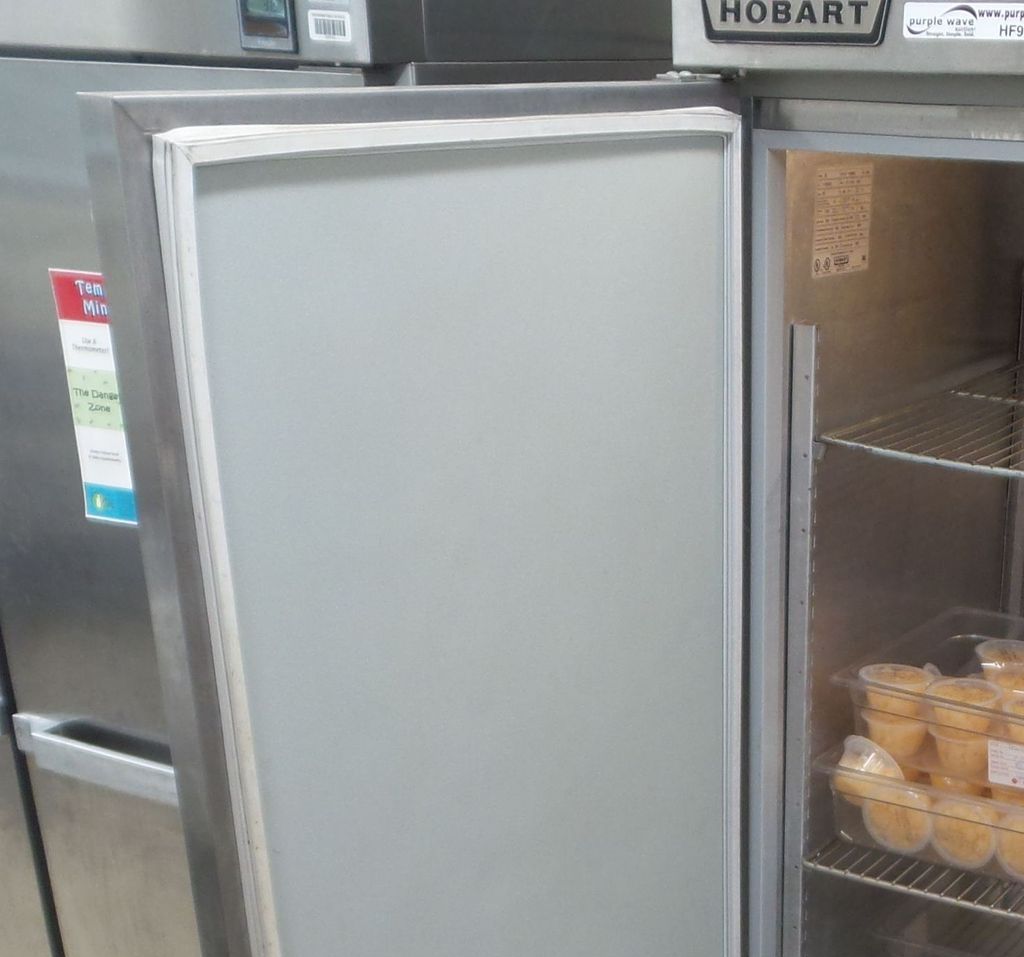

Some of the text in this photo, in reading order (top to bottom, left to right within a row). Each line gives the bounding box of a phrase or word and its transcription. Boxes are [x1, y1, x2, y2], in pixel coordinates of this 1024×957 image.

[720, 0, 868, 24] HOBART
[909, 16, 974, 27] purple wave
[73, 388, 89, 397] The
[88, 403, 111, 413] Zone
